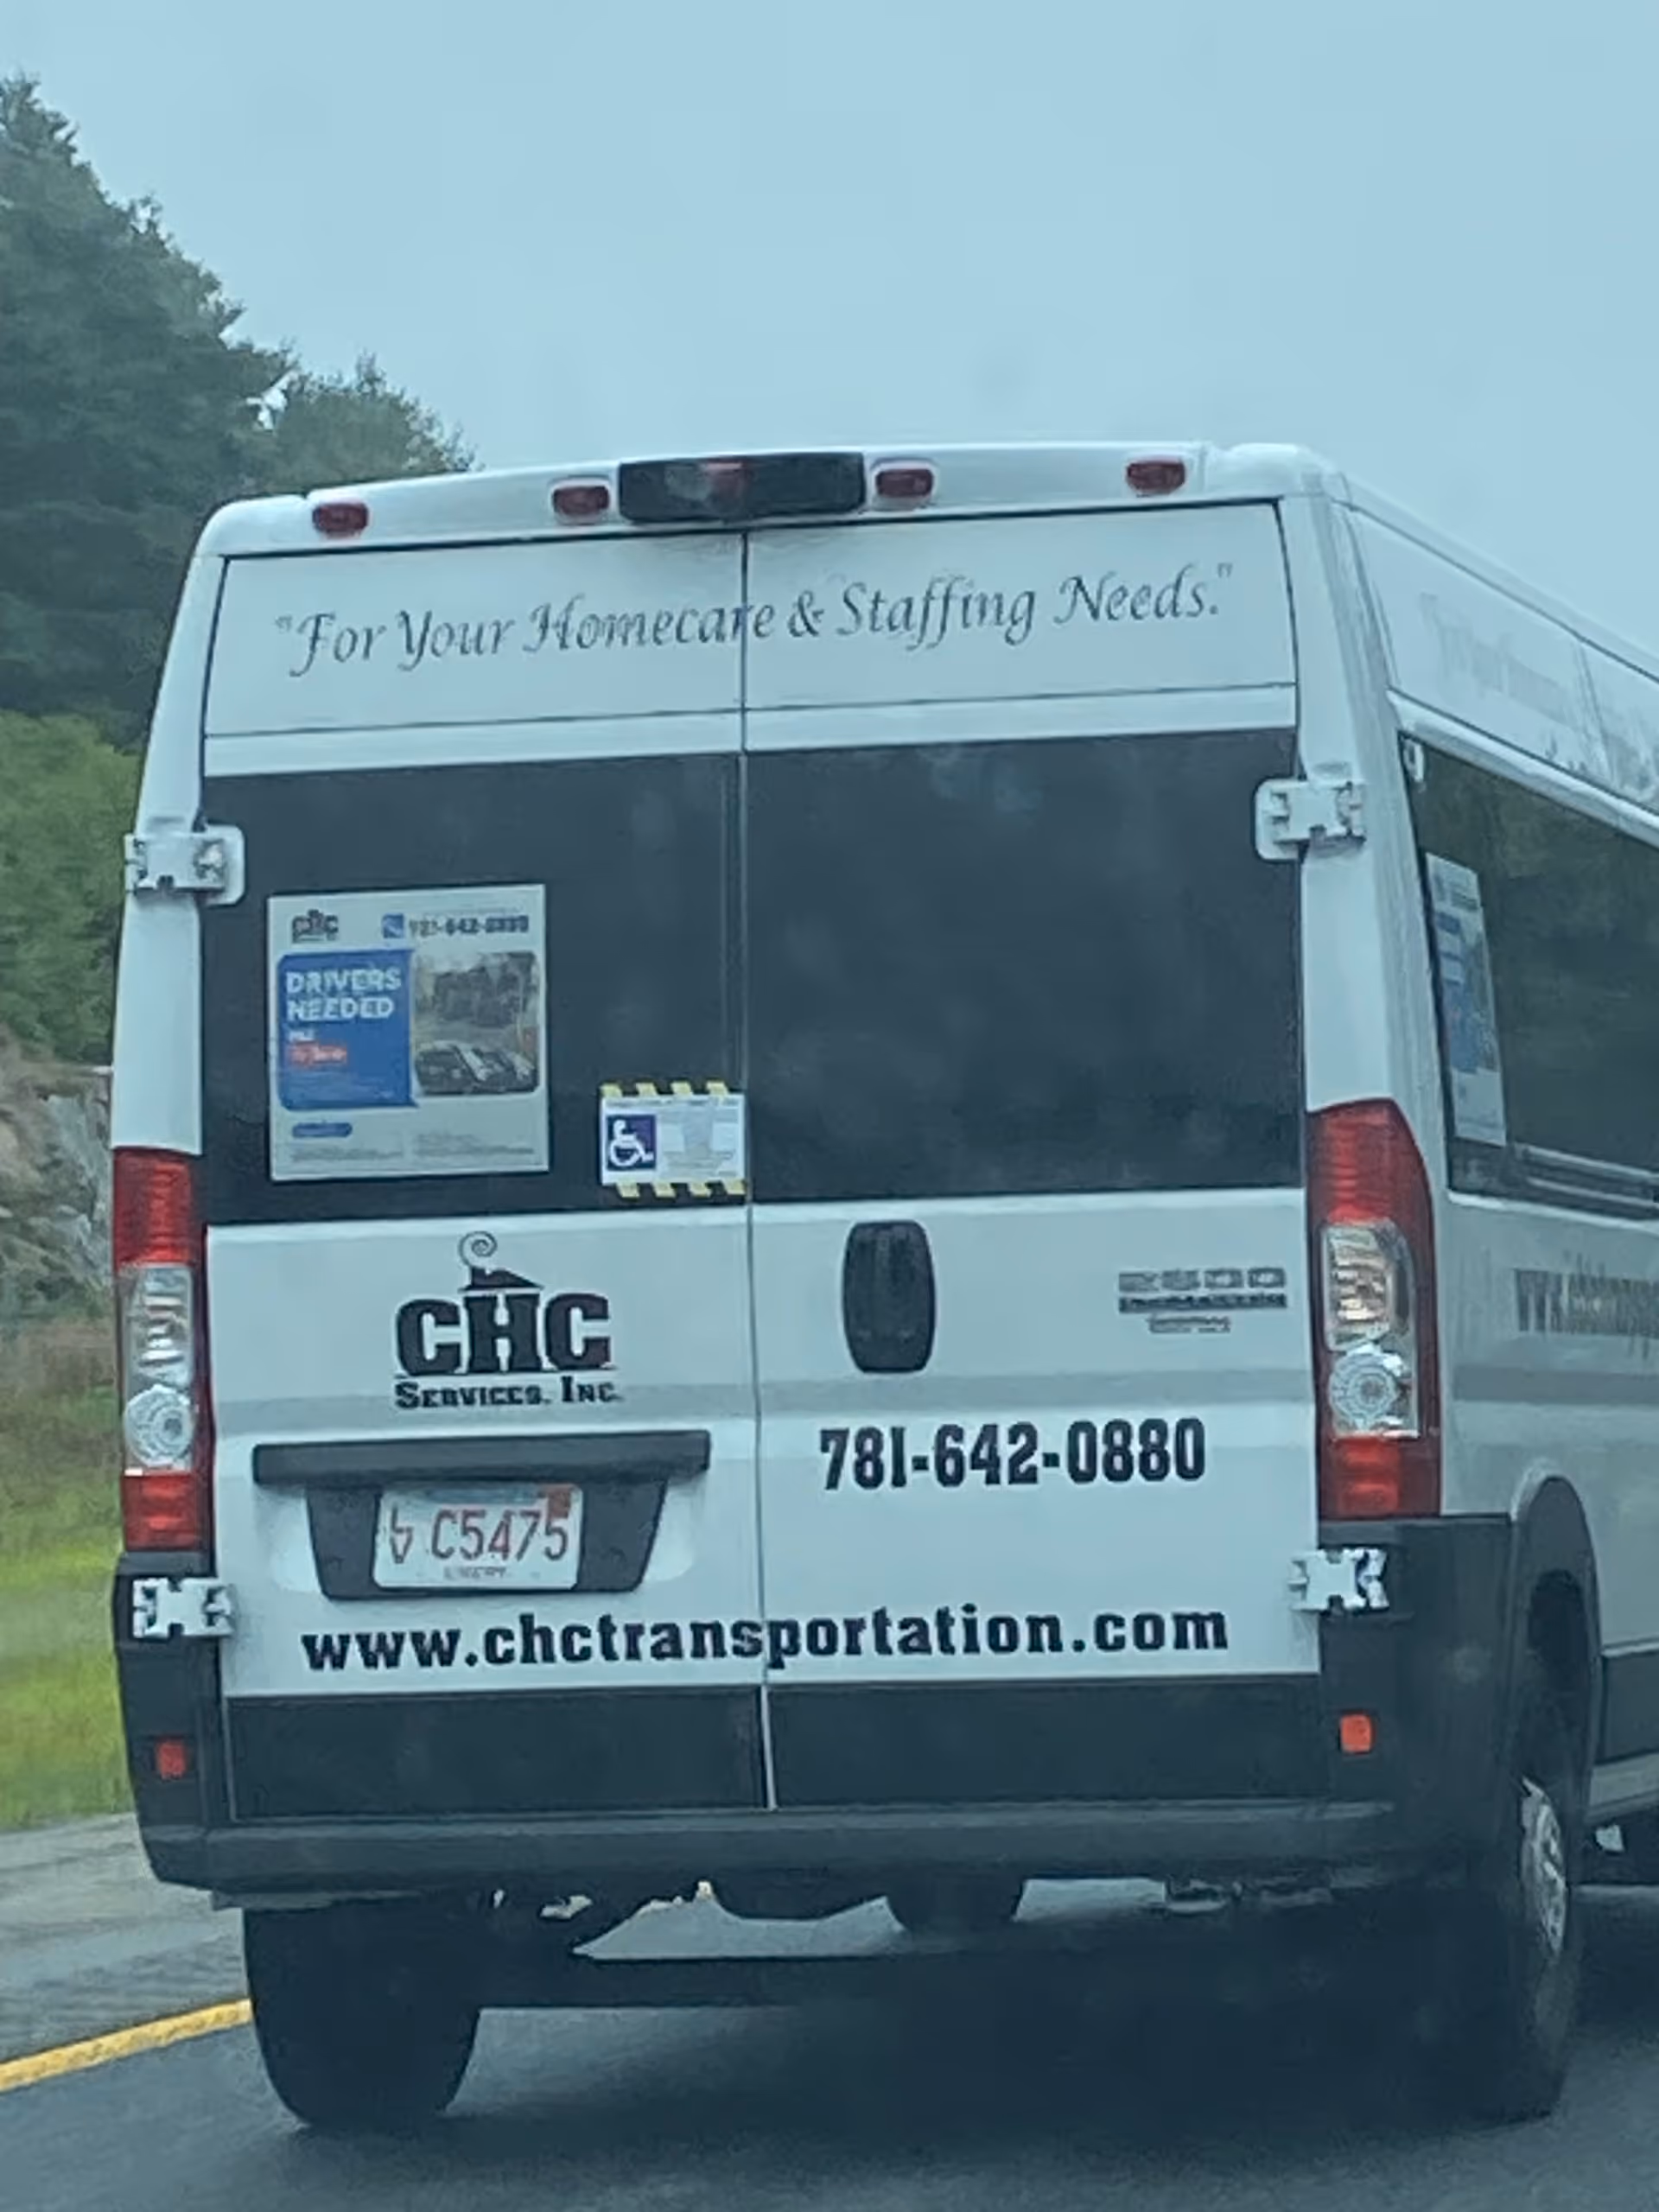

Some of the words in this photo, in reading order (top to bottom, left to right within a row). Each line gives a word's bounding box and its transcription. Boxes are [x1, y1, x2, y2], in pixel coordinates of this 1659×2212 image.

[397, 608, 515, 671] Your
[521, 594, 776, 654] Homecare
[787, 589, 825, 639] &
[836, 570, 1036, 651] Staffing
[286, 968, 402, 995] DRIVERS
[286, 997, 395, 1022] NEEDED
[396, 1293, 615, 1376] CHC
[820, 1417, 1206, 1491] 781-642-0880
[433, 1508, 569, 1561] C5475
[301, 1603, 1229, 1670] www.chctransportation.com
